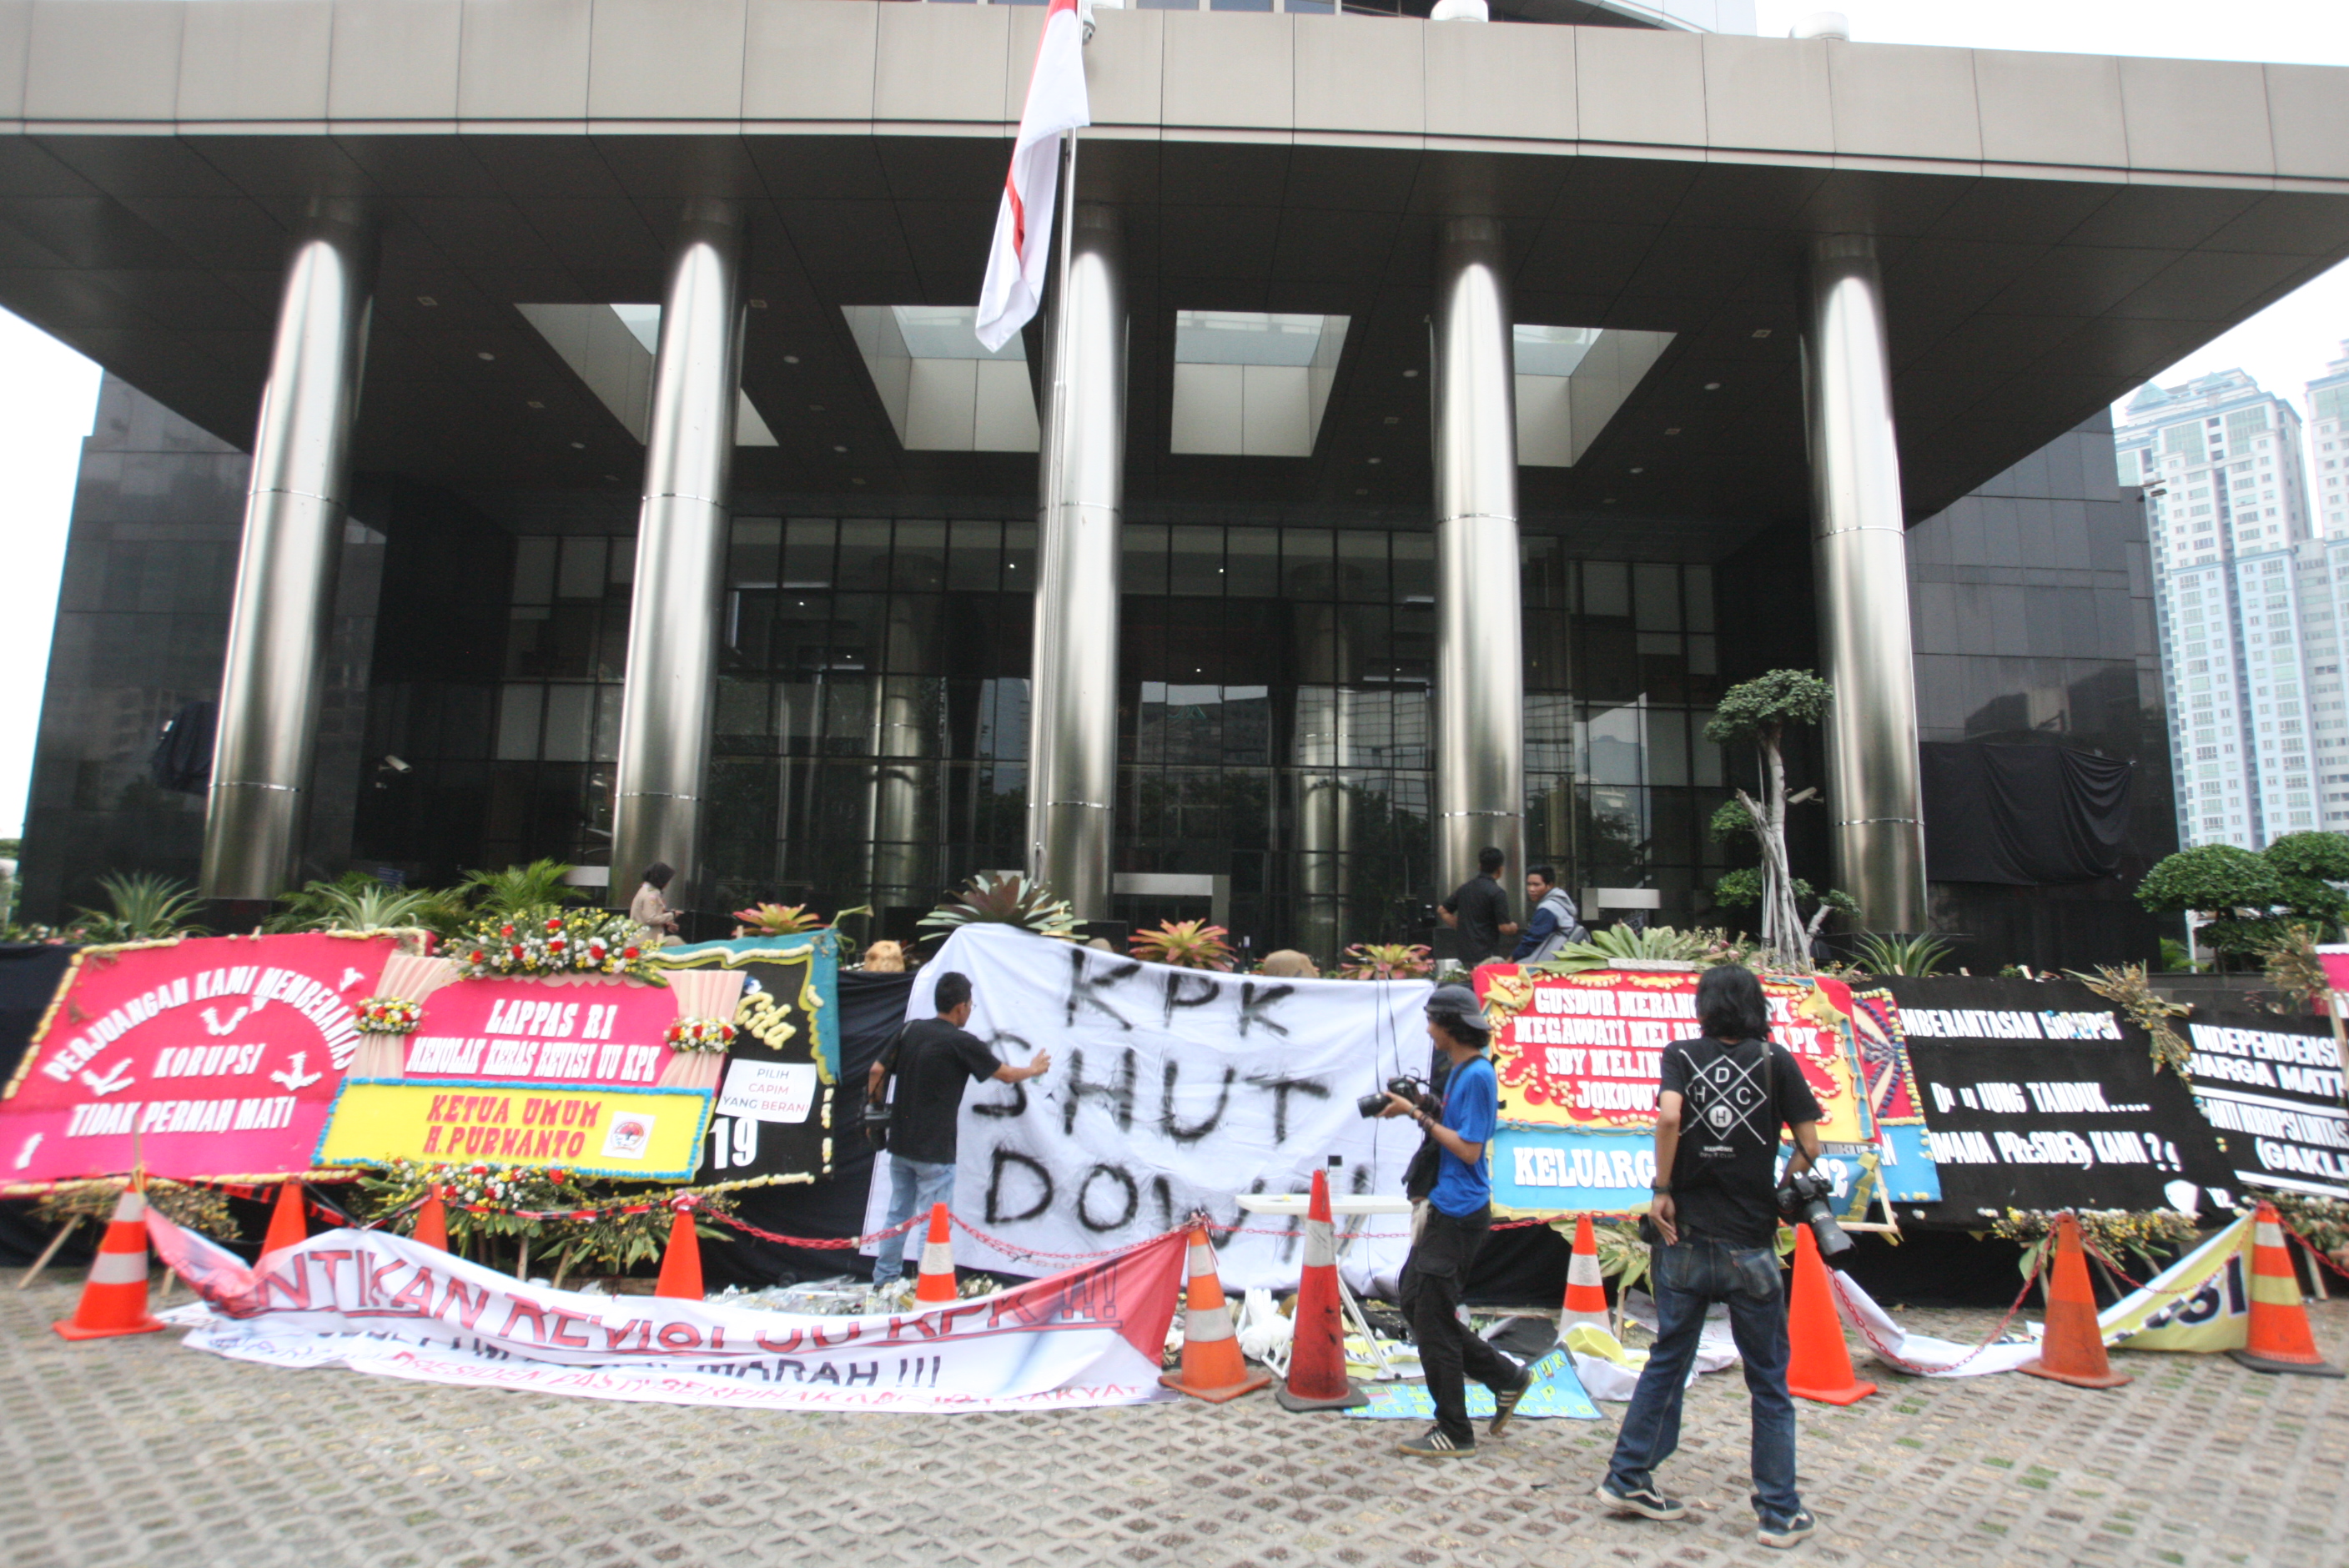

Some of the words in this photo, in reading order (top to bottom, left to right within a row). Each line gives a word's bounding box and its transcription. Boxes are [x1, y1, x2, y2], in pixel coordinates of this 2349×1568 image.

[1067, 947, 1295, 1037] KPK
[1534, 987, 1617, 1016] GUSDUR
[43, 977, 189, 1082] PERJUANGAN
[194, 965, 259, 1001] KAMI
[485, 998, 580, 1038] LAPPAS
[581, 1003, 618, 1040] RI
[1513, 1015, 1627, 1047] MEGAWATI
[1898, 1008, 2042, 1038] MBERANTASAN
[152, 1043, 266, 1078] KORUPSI
[405, 1037, 487, 1074] MENOLAK
[481, 1039, 540, 1076] KERAS
[533, 1043, 598, 1078] REVISI
[596, 1044, 624, 1079] UU
[620, 1045, 661, 1082] KPK
[757, 1068, 790, 1080] PILIH
[1545, 1047, 1587, 1075] SBY
[1589, 1049, 1662, 1078] MELIN
[1715, 1067, 1730, 1083] D
[748, 1083, 790, 1095] CAPIM
[972, 1029, 1332, 1145] SHUT
[1577, 1081, 1661, 1111] JOKOW
[1694, 1086, 1707, 1103] H
[1736, 1086, 1752, 1105] C
[67, 1101, 141, 1137] TIDAK
[140, 1098, 238, 1133] PERNAH
[234, 1095, 297, 1130] MATI
[426, 1094, 511, 1123] KETUA
[522, 1098, 602, 1128] UMUM
[723, 1096, 758, 1109] YANG
[761, 1100, 810, 1113] BERANI
[2088, 1131, 2150, 1163] KAMI
[1513, 1147, 1657, 1189] KELUARG
[255, 1249, 490, 1330] NTIKAN
